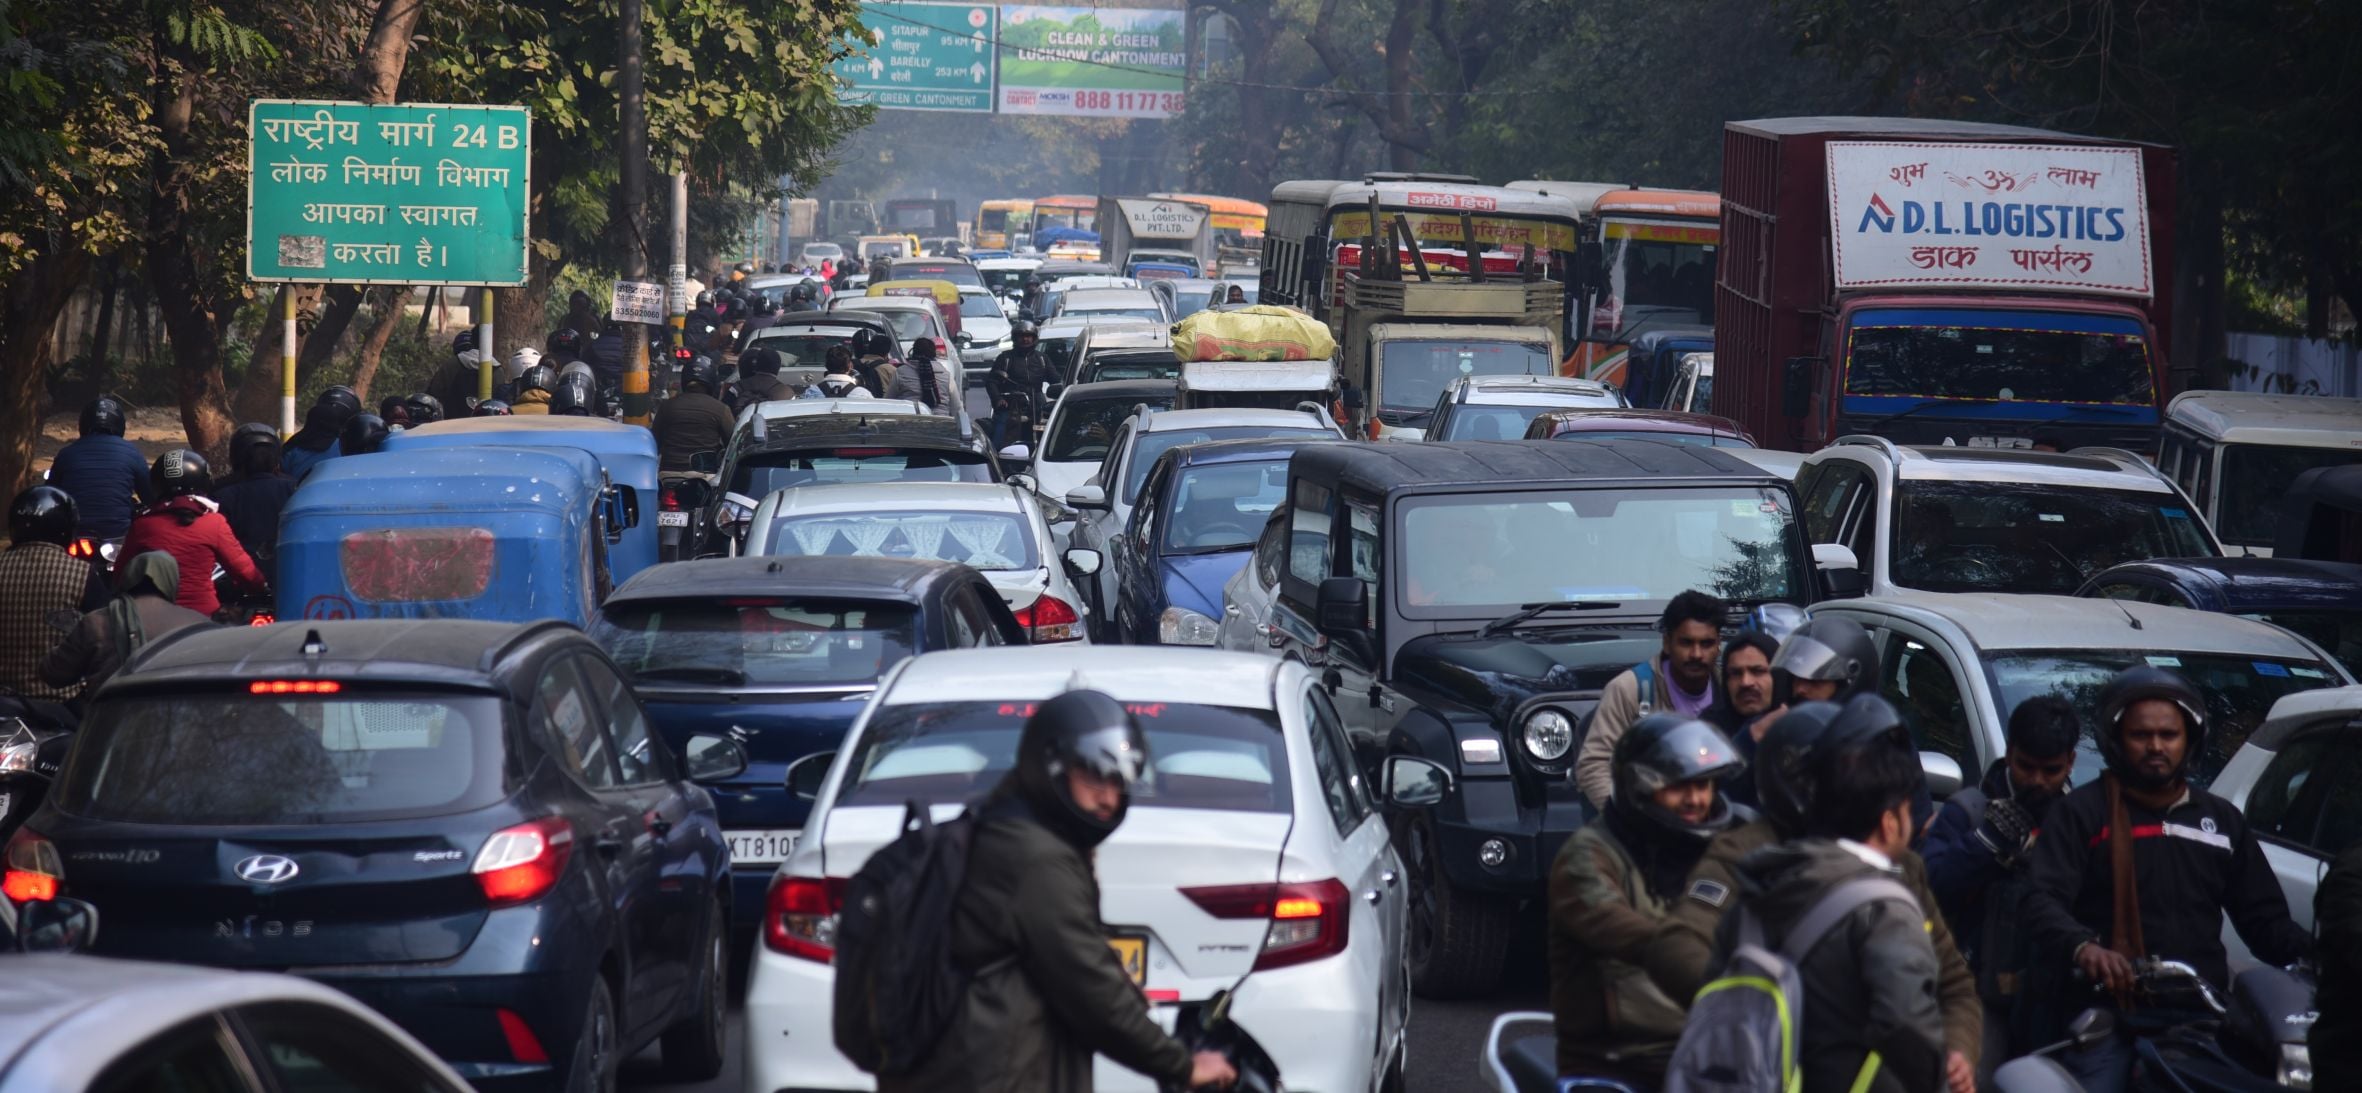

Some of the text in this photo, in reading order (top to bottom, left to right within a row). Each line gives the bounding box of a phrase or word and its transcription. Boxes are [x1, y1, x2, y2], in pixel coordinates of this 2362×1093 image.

[890, 25, 930, 37] SITAPUR
[1047, 31, 1160, 47] CLEAN & GREEN
[940, 36, 969, 47] 95 KM
[889, 56, 932, 68] BAREILLY
[1018, 48, 1186, 66] LUCKNOW CANTONMENT
[851, 64, 866, 74] KM
[953, 68, 968, 77] KM
[880, 92, 911, 105] GREEN
[914, 93, 977, 106] CANTONMENT
[1074, 90, 1111, 110] 888
[1117, 92, 1134, 110] 11
[1138, 92, 1157, 111] 77
[262, 110, 520, 151] राष्ट्रीय मार्ग 24 B
[270, 155, 511, 189] लोक निर्माण विभाग
[1889, 162, 1929, 187] शुभ
[2047, 166, 2101, 190] लाभ
[1409, 192, 1496, 211] अमेठी डिपो
[302, 203, 479, 227] आपका स्वागत
[332, 243, 402, 265] करता
[1907, 243, 2094, 277] डाक पार्सल
